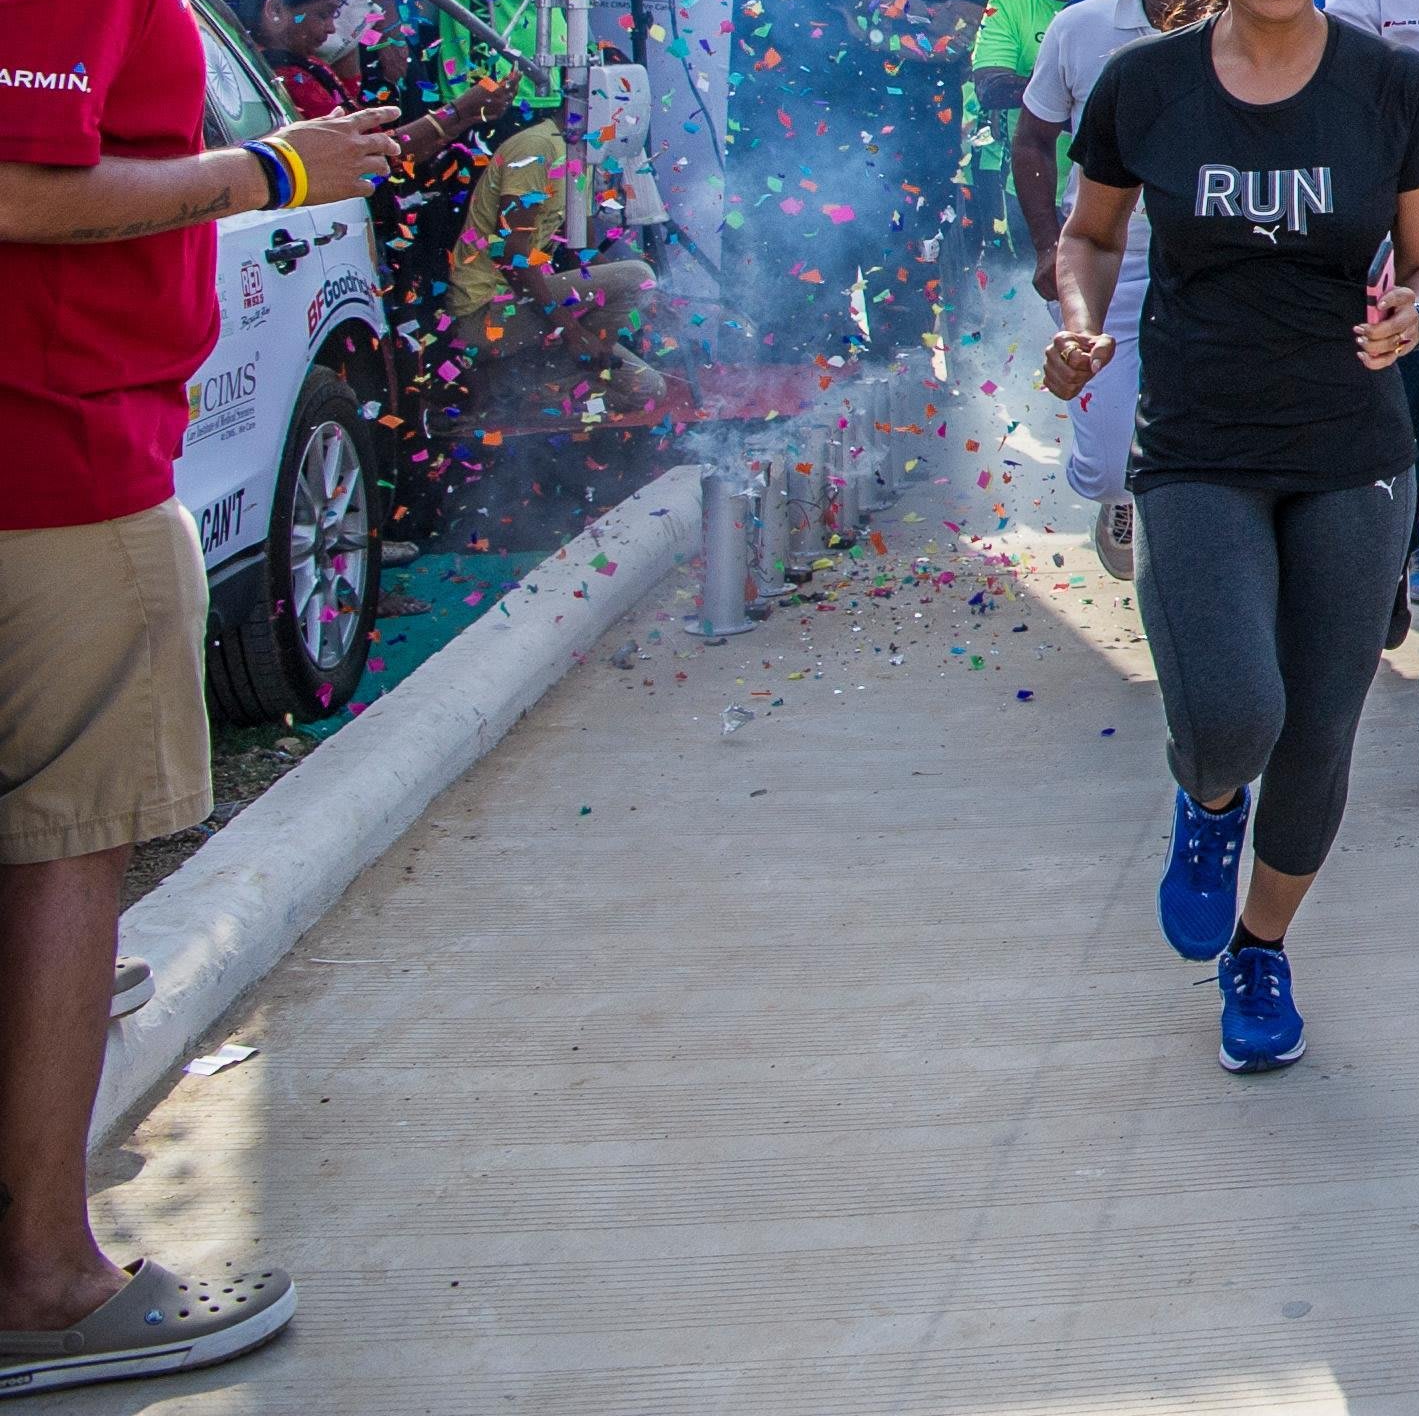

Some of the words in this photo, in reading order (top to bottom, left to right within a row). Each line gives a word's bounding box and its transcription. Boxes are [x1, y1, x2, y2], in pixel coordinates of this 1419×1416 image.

[1195, 164, 1334, 235] RUN
[242, 265, 263, 295] RED
[204, 362, 257, 413] CIMS
[201, 488, 246, 556] CAN'T
